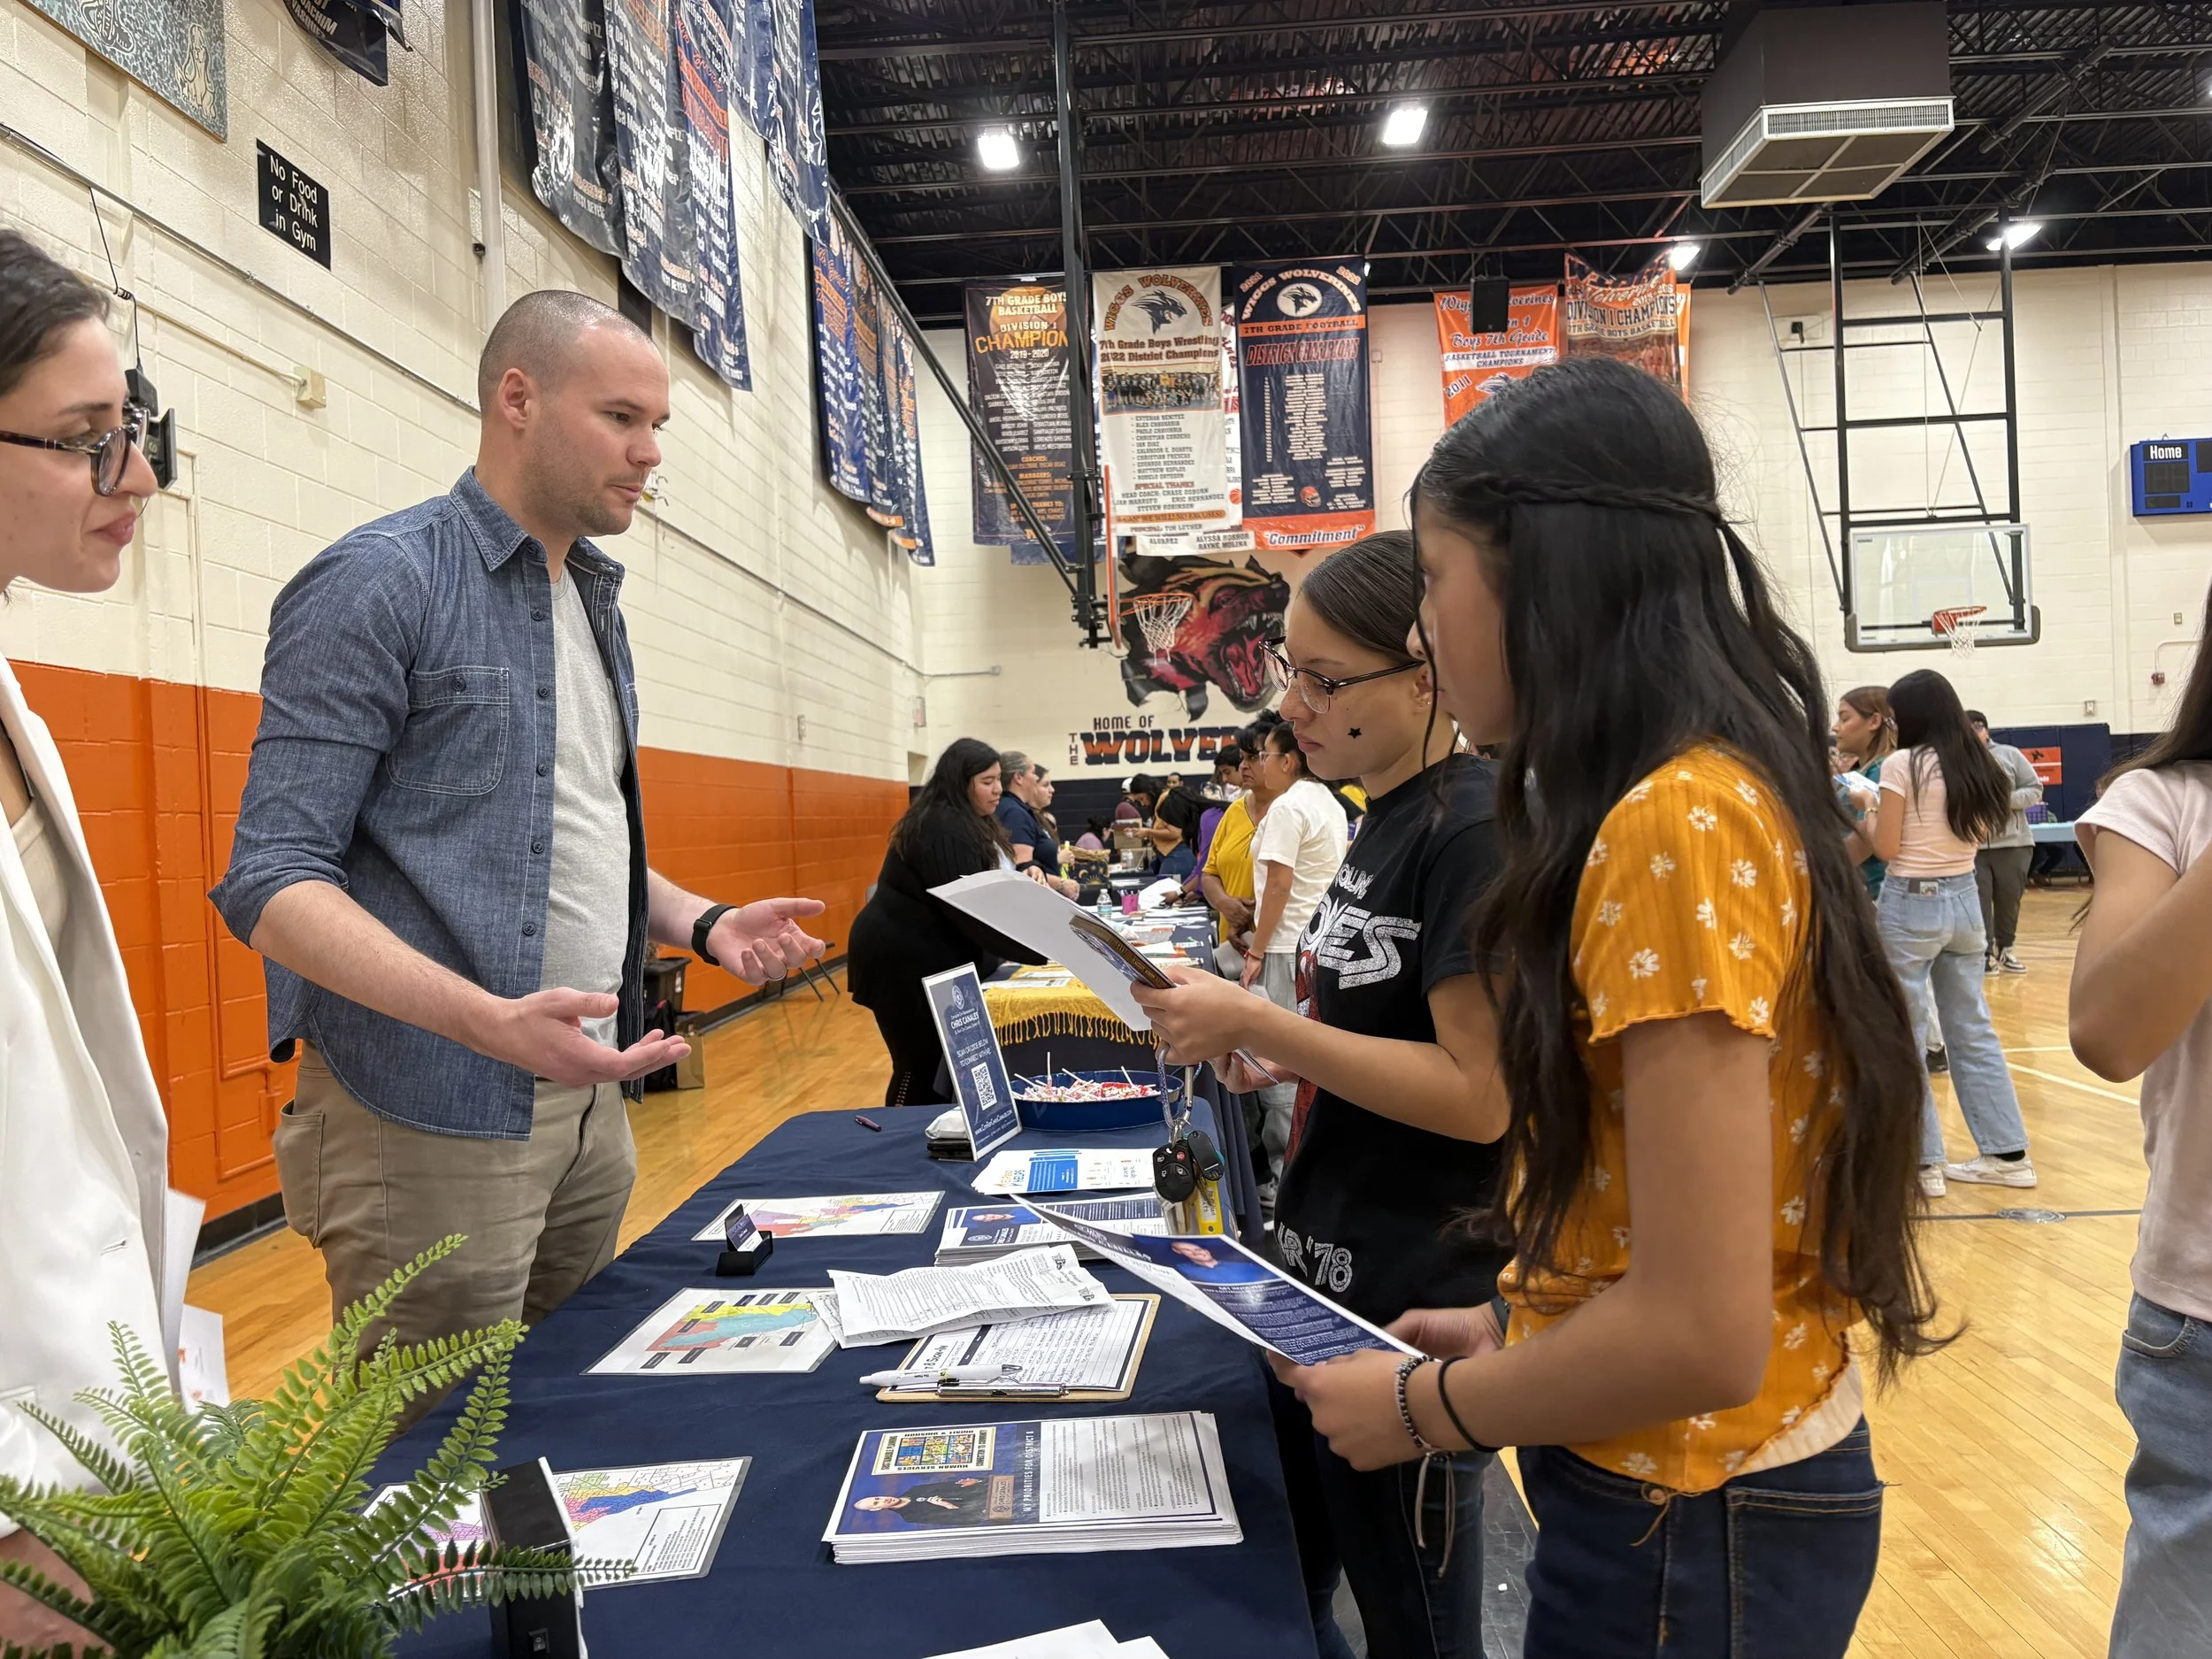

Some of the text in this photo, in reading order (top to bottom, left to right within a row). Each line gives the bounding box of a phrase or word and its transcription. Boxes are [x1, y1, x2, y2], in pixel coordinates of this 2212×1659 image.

[270, 155, 318, 204] No Food
[272, 185, 319, 228] or Drink
[275, 209, 316, 251] in Gym
[985, 296, 1005, 306] 7TH
[1007, 295, 1041, 306] GRADE
[1278, 269, 1362, 313] WOLVERINES
[997, 304, 1057, 316] BASKETBALL
[1104, 273, 1213, 332] WIGGS WOLVERINES
[1567, 300, 1606, 326] DIVISION
[1617, 296, 1676, 326] CHAMPIONS
[1000, 321, 1048, 333] DIVISION
[1305, 319, 1358, 330] FOOTBALL
[1099, 335, 1219, 350] 7th Grade Boys Wrestling
[1101, 349, 1219, 363] 2022 District Champions
[1446, 350, 1497, 362] BASKETBALL
[1444, 374, 1472, 398] 2011
[2149, 445, 2183, 460] Home
[1094, 715, 1155, 731] HOME OF
[1069, 733, 1079, 765] THE
[950, 1018, 963, 1029] CHRIS
[963, 1011, 979, 1025] CANALES
[1305, 1235, 1353, 1293] '78
[1025, 1435, 1034, 1458] DISTRICT
[1025, 1459, 1033, 1470] FOR
[1023, 1471, 1033, 1502] PRIORITIES
